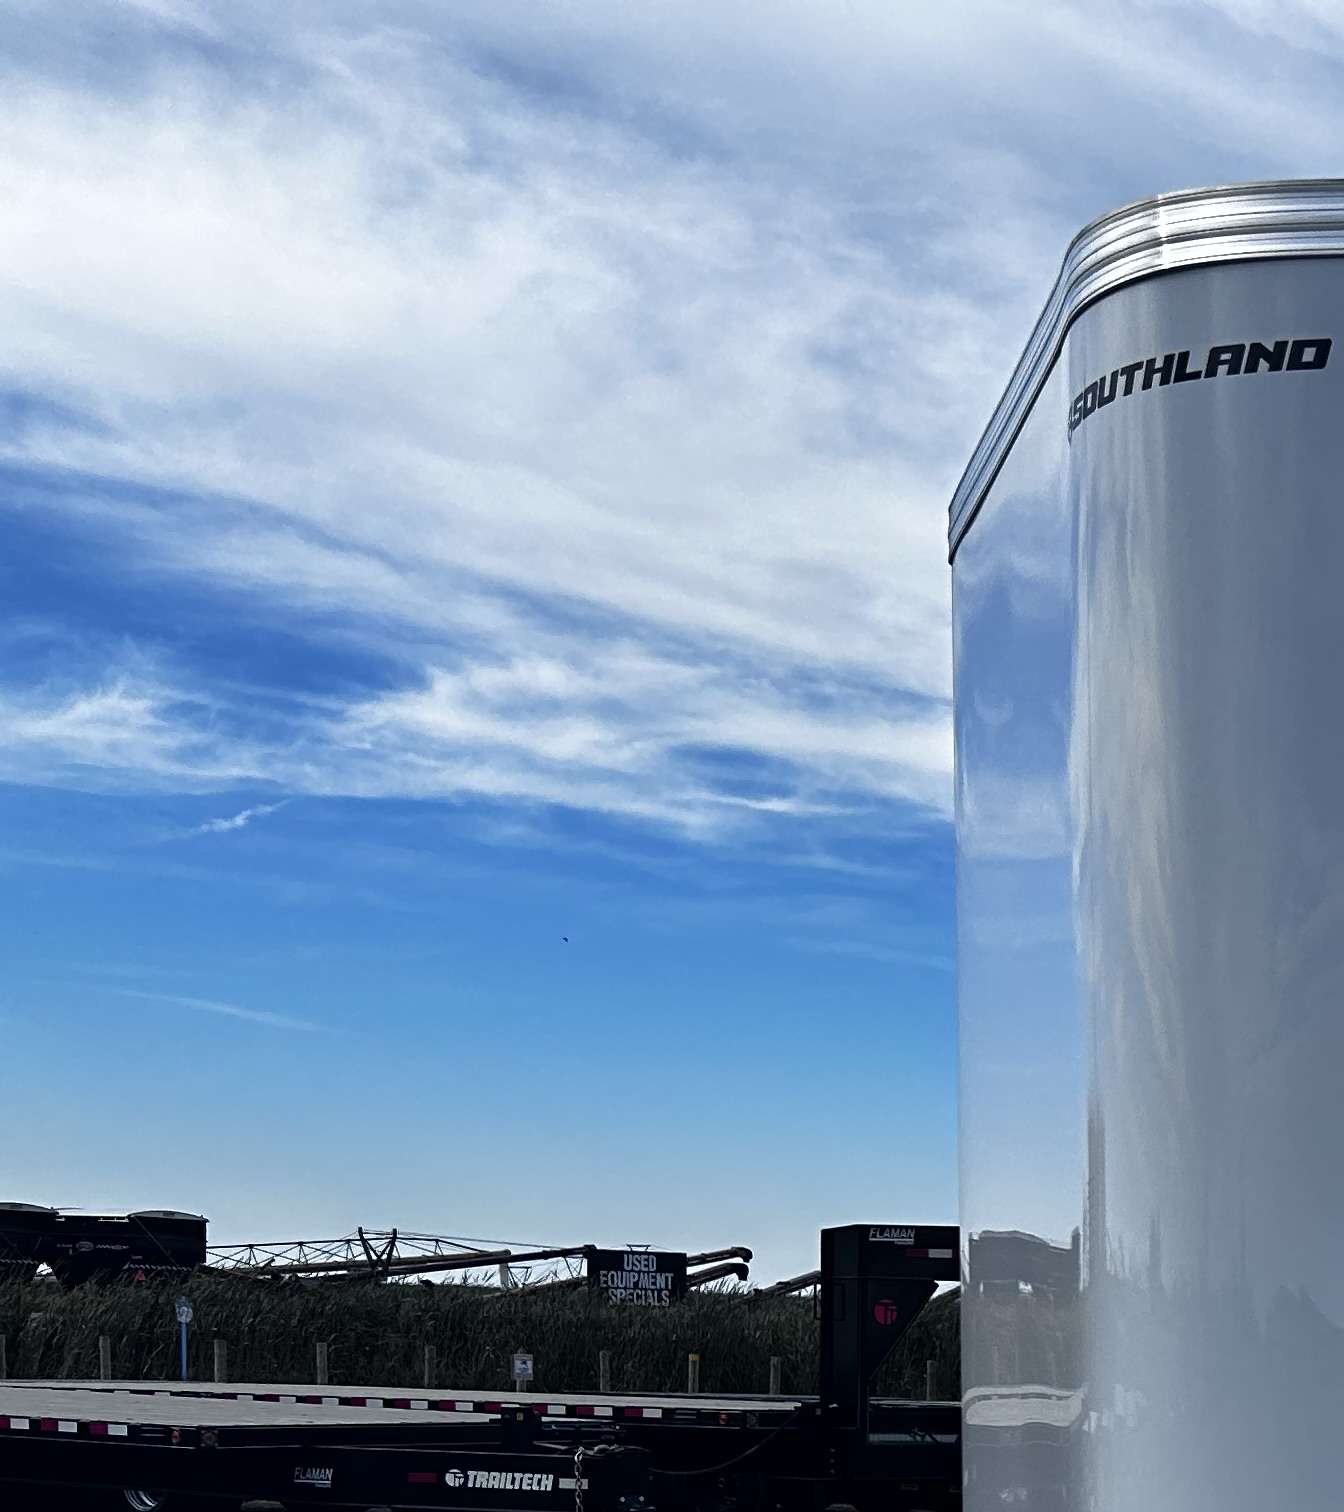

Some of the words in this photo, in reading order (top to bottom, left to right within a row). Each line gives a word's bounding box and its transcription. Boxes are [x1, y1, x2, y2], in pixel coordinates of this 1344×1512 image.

[1071, 338, 1333, 430] SOUTHLAND
[869, 1227, 915, 1238] FLAMAN
[623, 1253, 657, 1271] USED
[599, 1270, 675, 1290] EQUIPMENT
[608, 1288, 671, 1307] SPECIALS
[294, 1467, 334, 1481] FLAMAN
[467, 1470, 554, 1491] TRAILTECH
